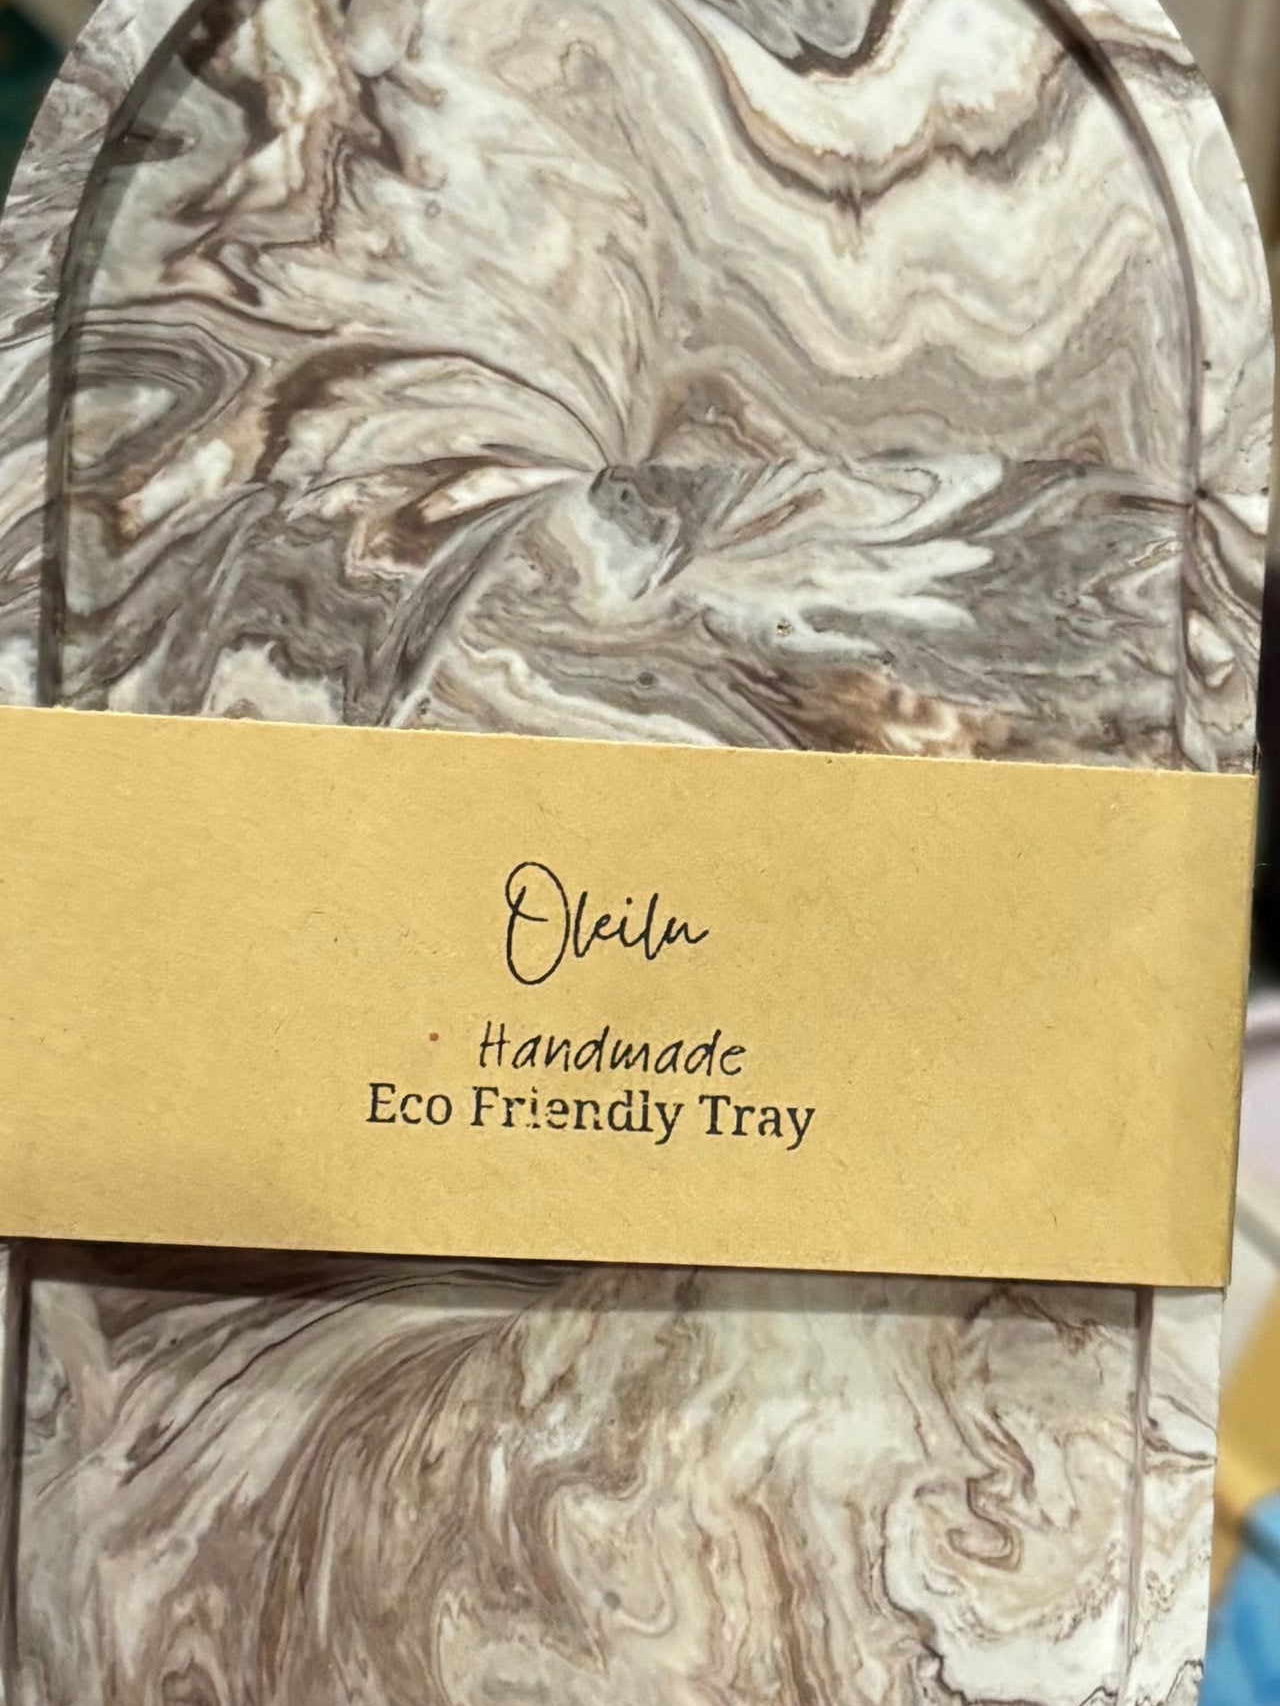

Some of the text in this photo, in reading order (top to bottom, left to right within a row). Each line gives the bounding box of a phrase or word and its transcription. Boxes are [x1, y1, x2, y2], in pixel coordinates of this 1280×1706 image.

[479, 1019, 748, 1078] Handmade
[364, 1081, 817, 1152] Eco Friendly Tray
